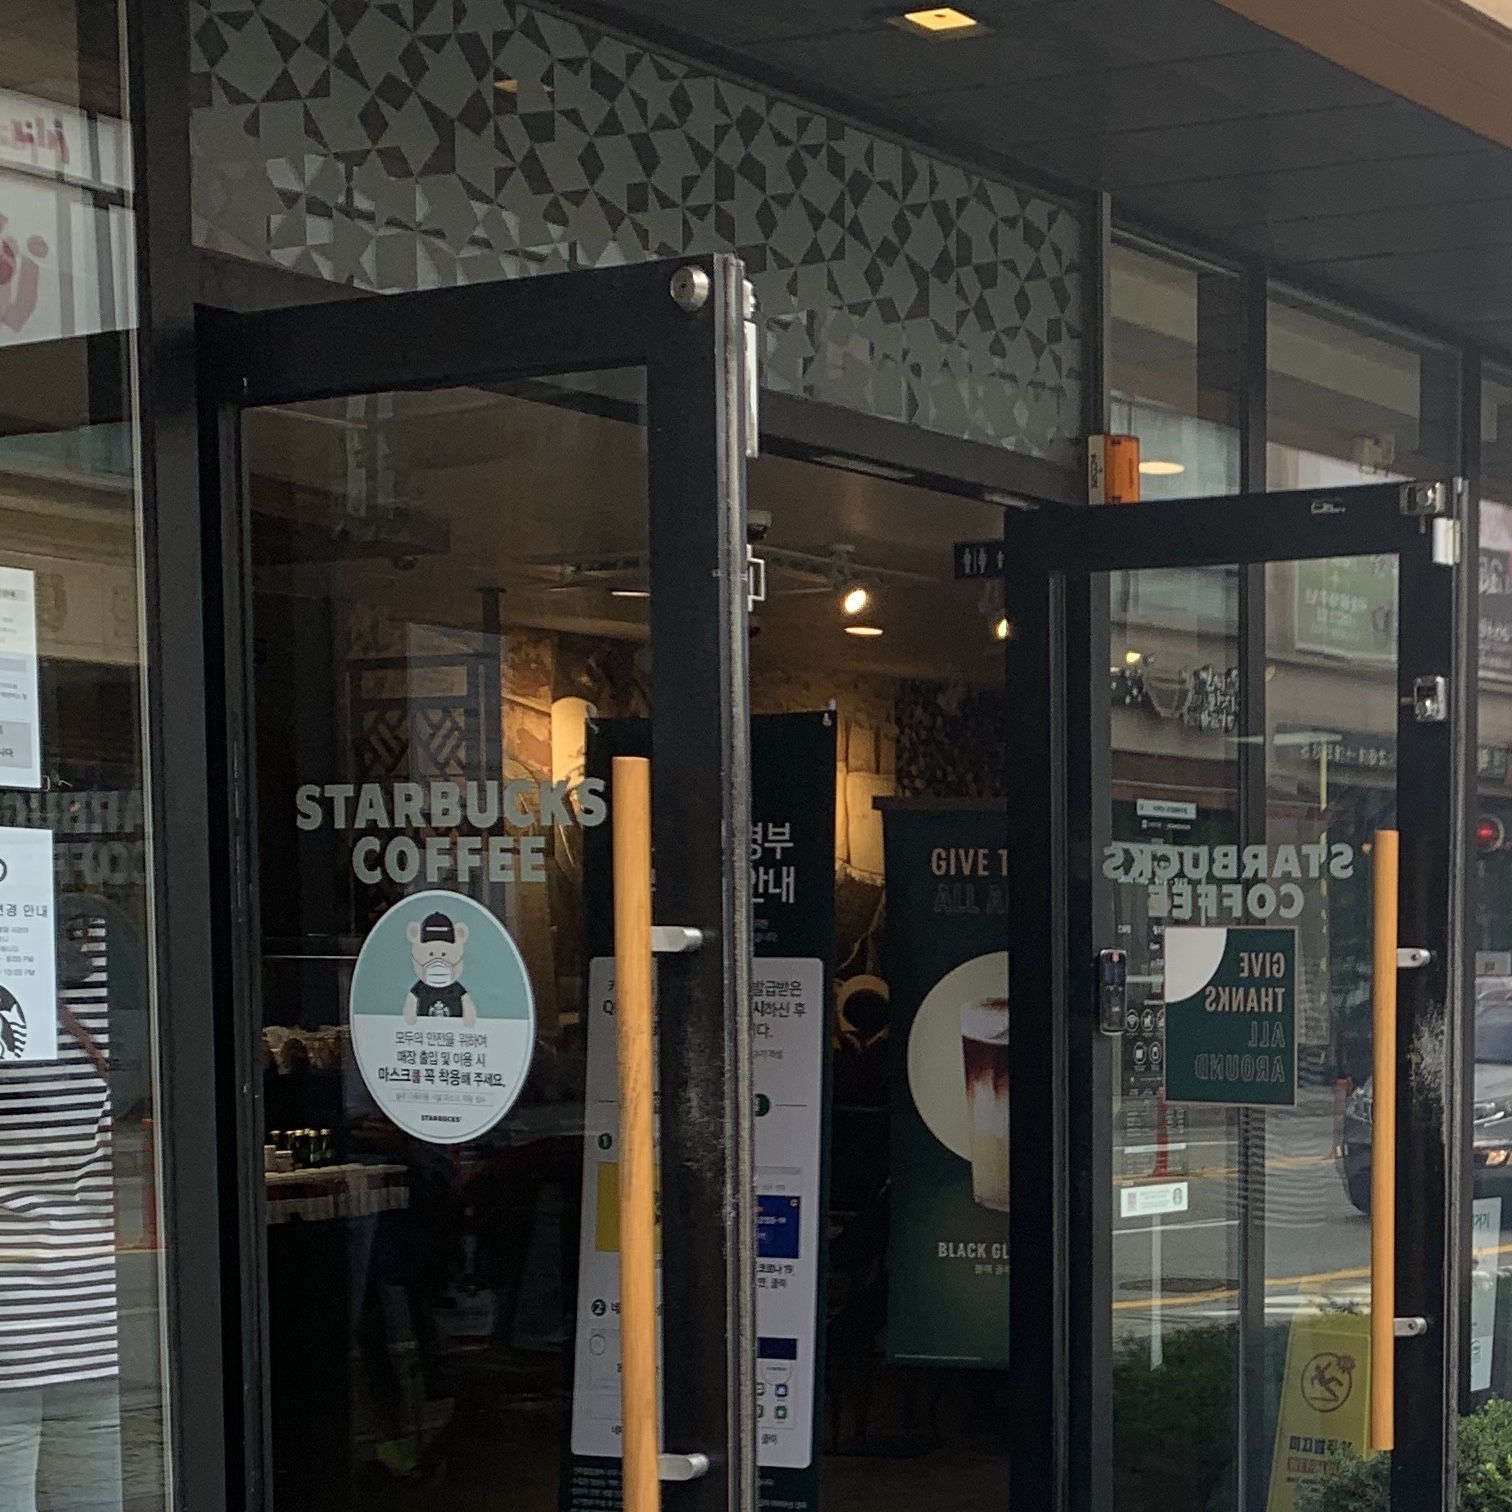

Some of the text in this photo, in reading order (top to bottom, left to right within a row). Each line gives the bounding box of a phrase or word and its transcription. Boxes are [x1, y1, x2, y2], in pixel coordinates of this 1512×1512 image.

[296, 778, 607, 830] STARBUCKS
[352, 836, 547, 884] COFFEE
[931, 848, 990, 876] GIVE
[423, 1068, 436, 1085] 꼭
[938, 1242, 987, 1258] BLACK
